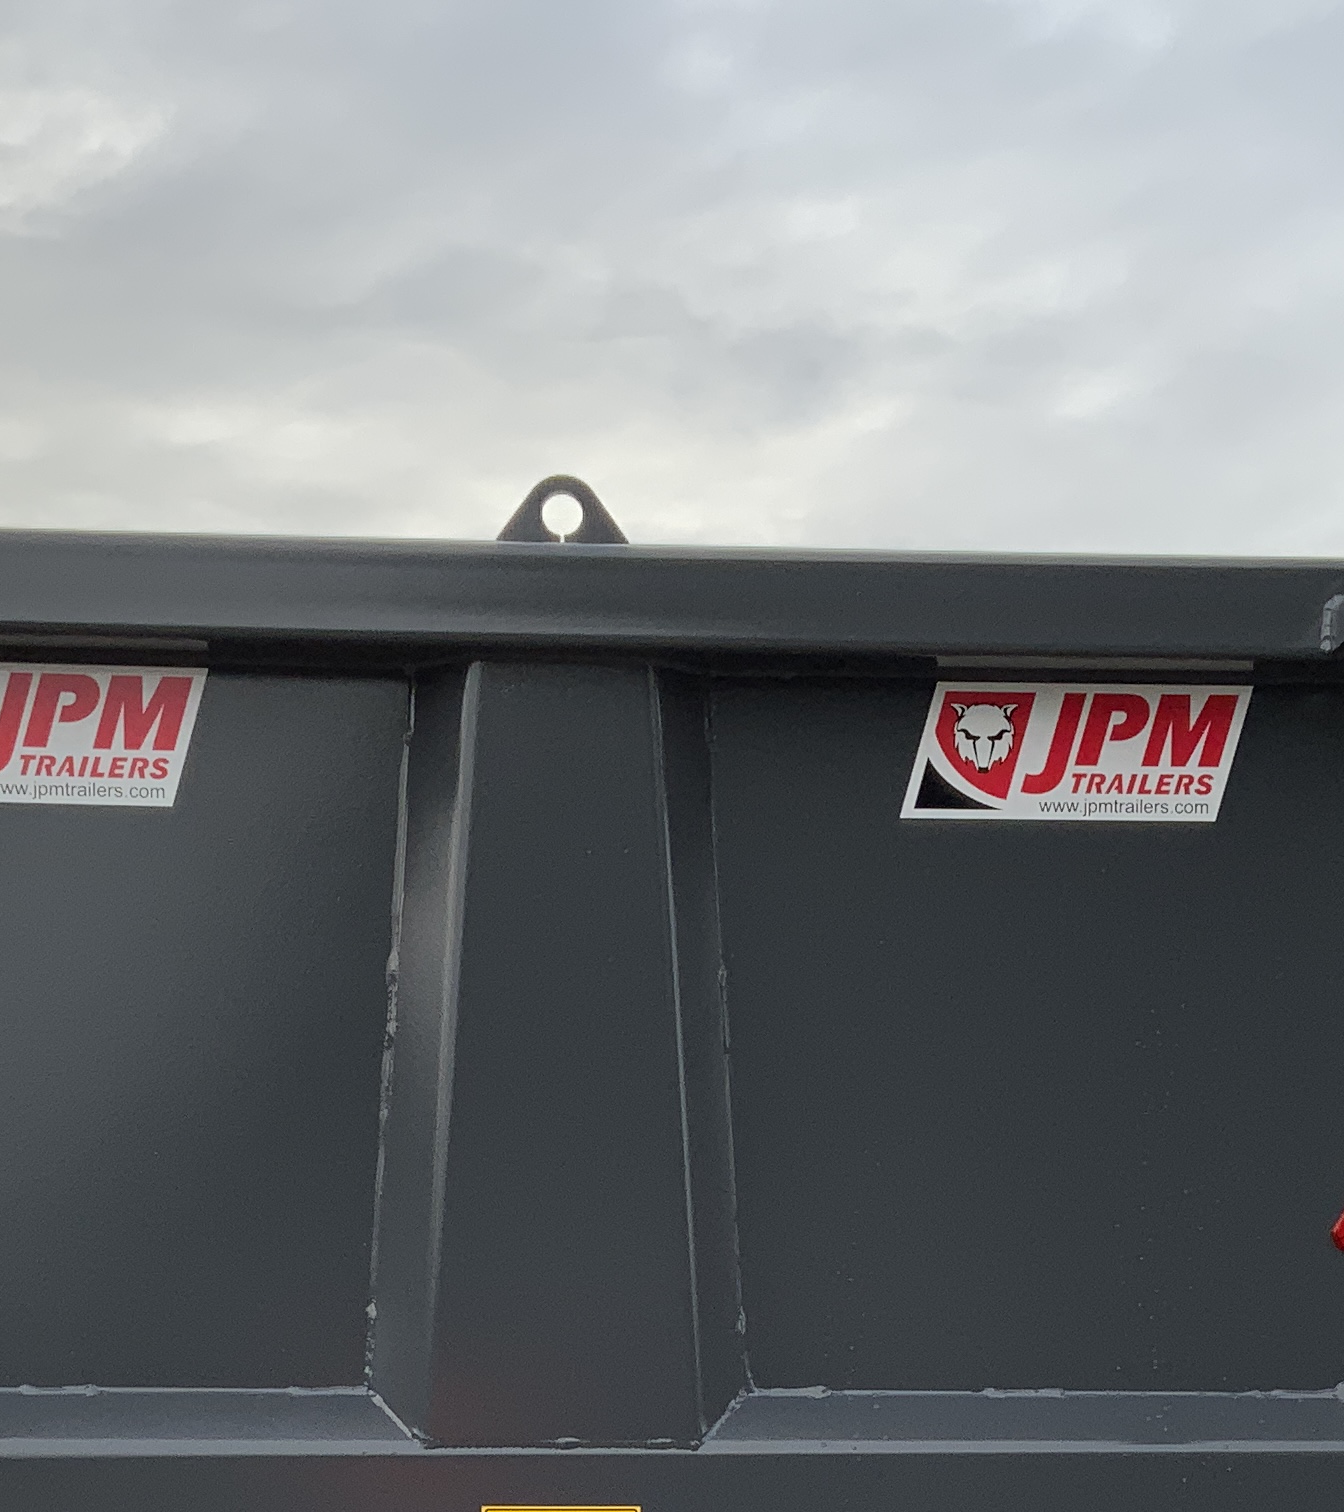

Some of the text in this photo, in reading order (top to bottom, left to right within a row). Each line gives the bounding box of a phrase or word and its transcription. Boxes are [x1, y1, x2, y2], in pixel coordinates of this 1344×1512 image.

[1021, 692, 1239, 794] JPM
[19, 755, 170, 780] TRAILERS
[1071, 772, 1215, 796] TRAILERS
[1038, 798, 1210, 818] www.jpmtrailers.com
